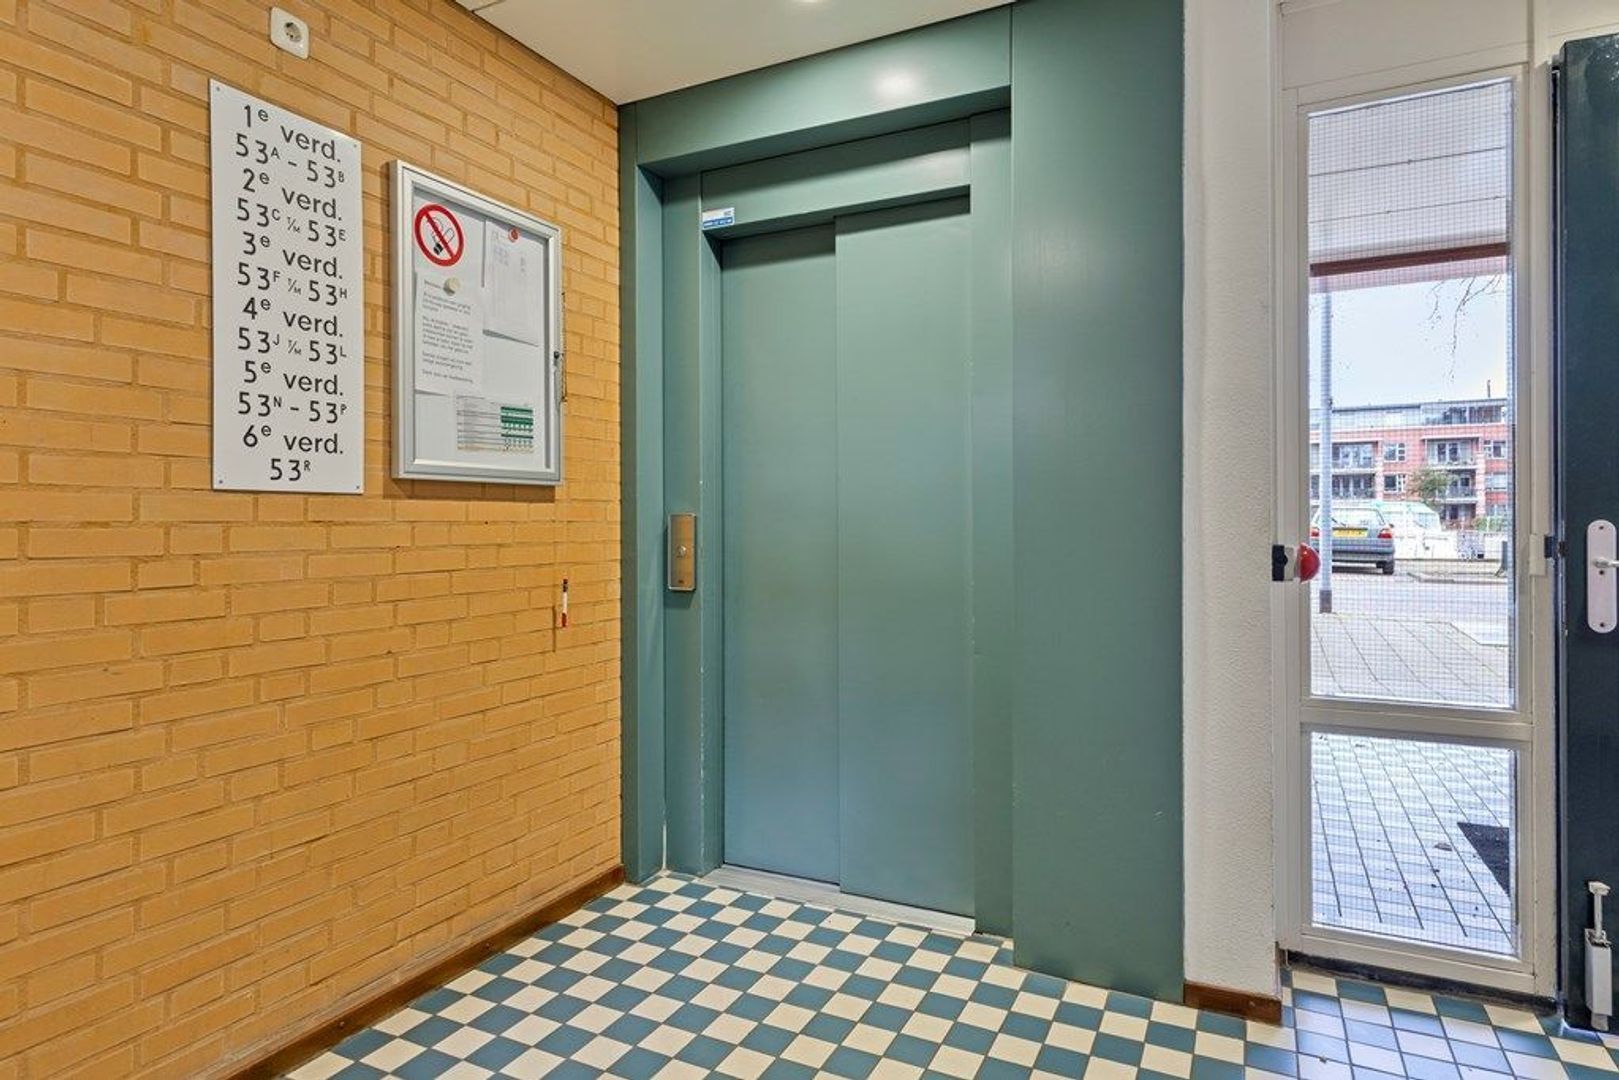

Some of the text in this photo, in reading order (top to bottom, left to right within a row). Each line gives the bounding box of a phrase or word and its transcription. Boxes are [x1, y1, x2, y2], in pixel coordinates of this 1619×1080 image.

[236, 133, 281, 165] 53A
[243, 105, 341, 163] 1e verd.
[243, 168, 342, 222] 2e verd.
[236, 197, 281, 228] 53C
[307, 220, 346, 248] 53E
[243, 231, 343, 280] 3e verd.
[237, 262, 281, 290] 53F
[308, 280, 348, 307] 53H
[242, 297, 344, 338] 4e verd.
[237, 327, 280, 354] 53J
[308, 340, 347, 366] 53L
[243, 360, 344, 397] 5e verd.
[237, 391, 283, 418] 53N
[308, 400, 348, 425] 53P
[242, 425, 344, 455] 6e verd.
